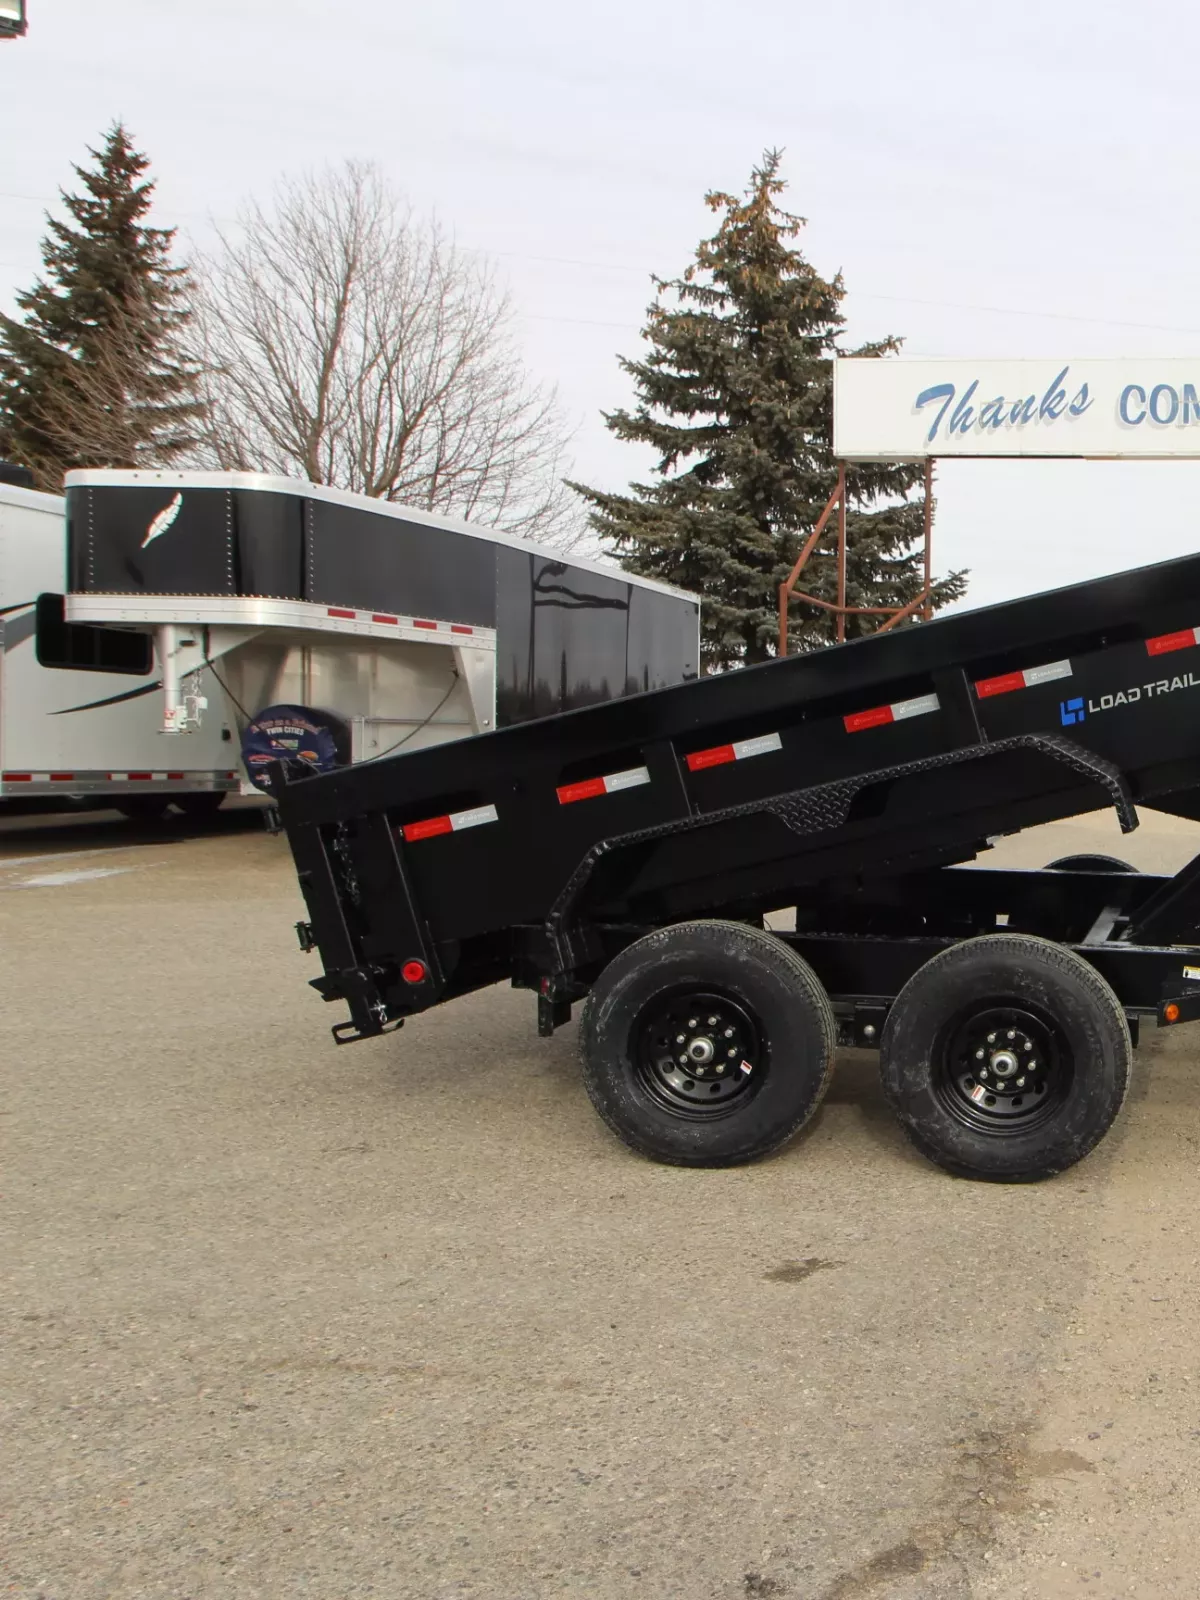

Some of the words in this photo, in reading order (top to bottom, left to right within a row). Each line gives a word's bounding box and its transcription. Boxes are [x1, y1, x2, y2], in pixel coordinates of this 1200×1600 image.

[915, 365, 1095, 442] Thanks
[1088, 687, 1141, 713] LOAD
[1143, 672, 1200, 698] TRAIL
